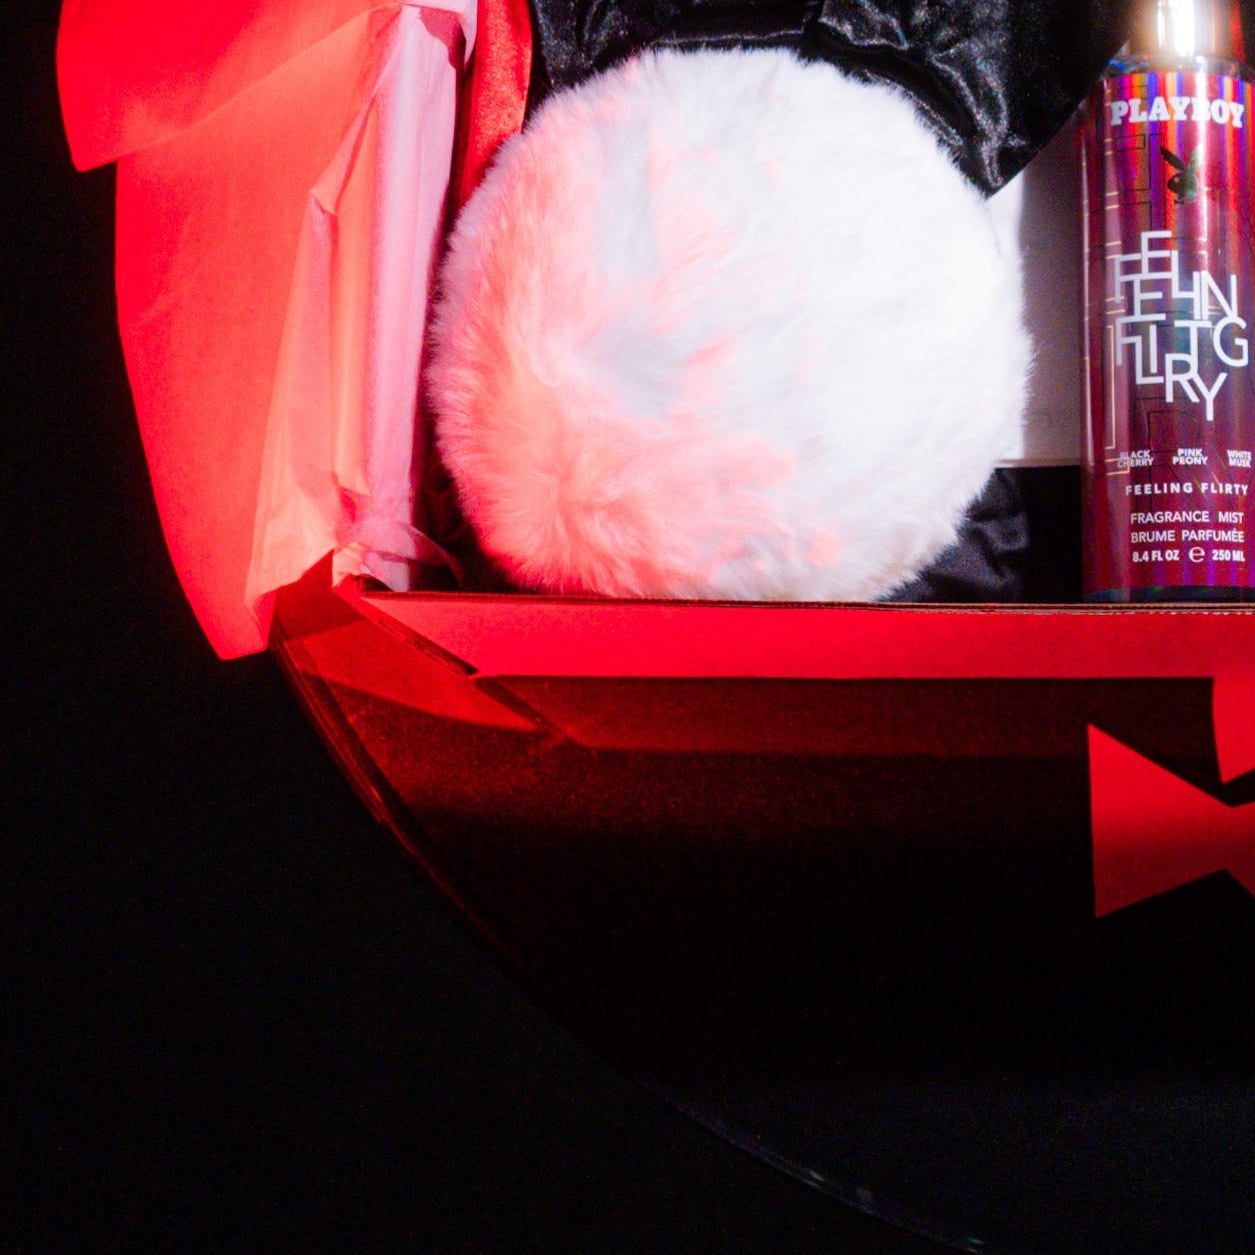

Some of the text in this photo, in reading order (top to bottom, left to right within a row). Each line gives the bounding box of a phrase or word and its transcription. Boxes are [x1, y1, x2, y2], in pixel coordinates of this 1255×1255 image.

[1111, 97, 1244, 128] PLAYBOY
[1120, 450, 1150, 459] BLACK
[1177, 448, 1203, 457] PINK
[1227, 450, 1252, 459] WHITE
[1117, 457, 1154, 468] CHERRY
[1172, 456, 1208, 465] PEONY
[1228, 458, 1251, 468] MUSK
[1125, 483, 1248, 495] FEELING FLIRTY
[1131, 510, 1244, 524] FRAGRANCE MIST
[1131, 528, 1245, 543] BRUME PARFUMÉE
[1132, 550, 1149, 562] 8.4
[1152, 550, 1163, 561] FL
[1165, 549, 1179, 561] OZ
[1212, 549, 1230, 561] 250
[1232, 550, 1245, 562] ML
